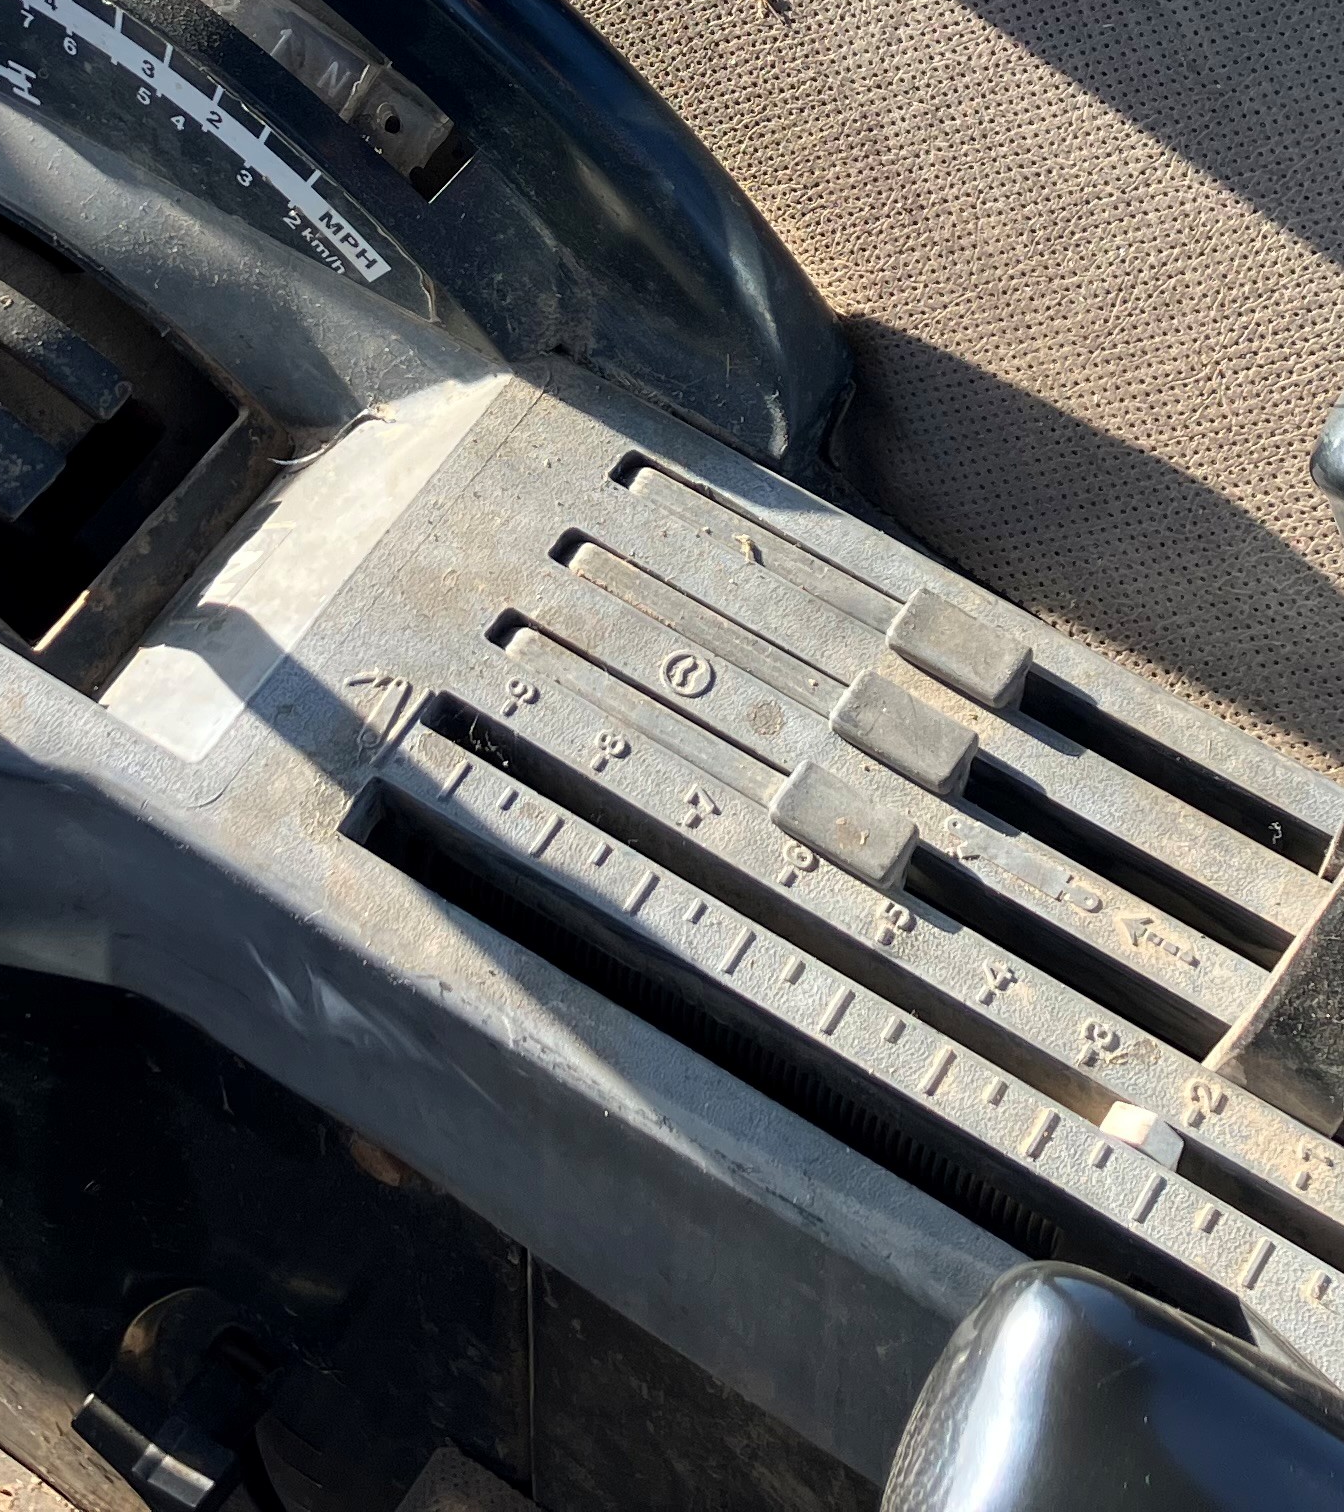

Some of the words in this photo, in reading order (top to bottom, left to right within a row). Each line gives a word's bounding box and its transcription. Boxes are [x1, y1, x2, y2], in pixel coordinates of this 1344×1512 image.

[20, 9, 35, 28] 7
[63, 37, 77, 56] 6
[136, 87, 151, 105] 5
[170, 115, 186, 131] 4
[236, 169, 253, 187] 3
[301, 227, 346, 274] km/h
[141, 60, 155, 78] 3
[206, 110, 223, 130] 2
[318, 210, 378, 270] MPH
[316, 61, 352, 98] N
[596, 728, 631, 758] 8
[685, 785, 721, 816] 7
[782, 840, 819, 872] 6
[983, 958, 1018, 992] 4
[1187, 1078, 1228, 1115] 2
